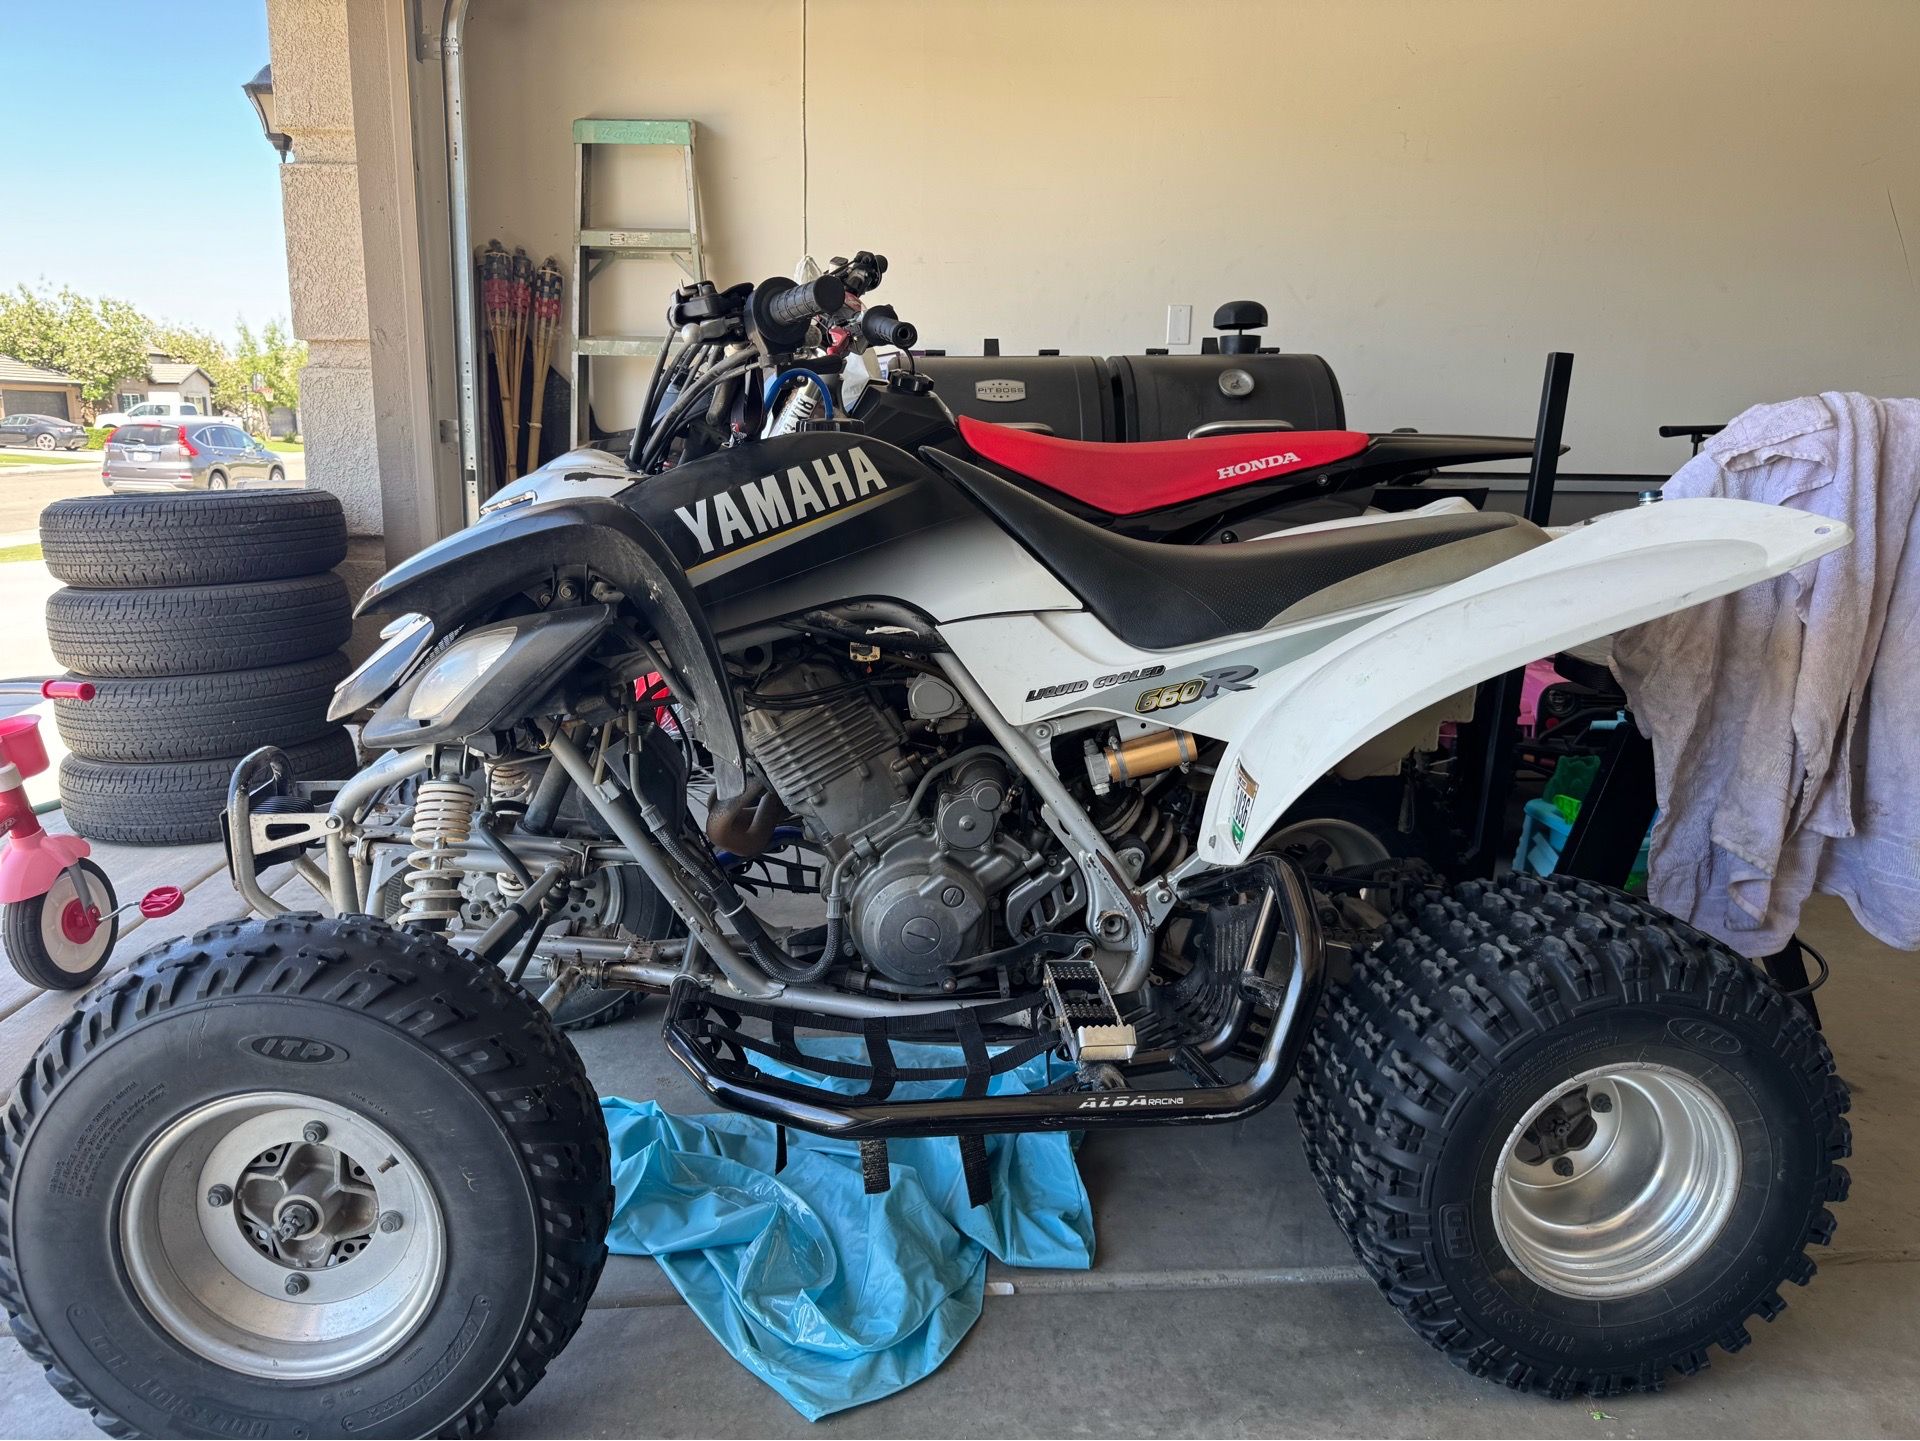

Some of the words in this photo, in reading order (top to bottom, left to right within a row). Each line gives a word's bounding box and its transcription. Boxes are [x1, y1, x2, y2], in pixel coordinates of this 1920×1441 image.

[1217, 452, 1301, 480] HONDA
[674, 446, 888, 554] YAMAHA
[1026, 680, 1088, 702] LIQUID
[1093, 664, 1166, 688] COOLED
[261, 1038, 327, 1060] ITP
[1079, 1095, 1147, 1109] ALBA
[1148, 1097, 1184, 1106] RACING
